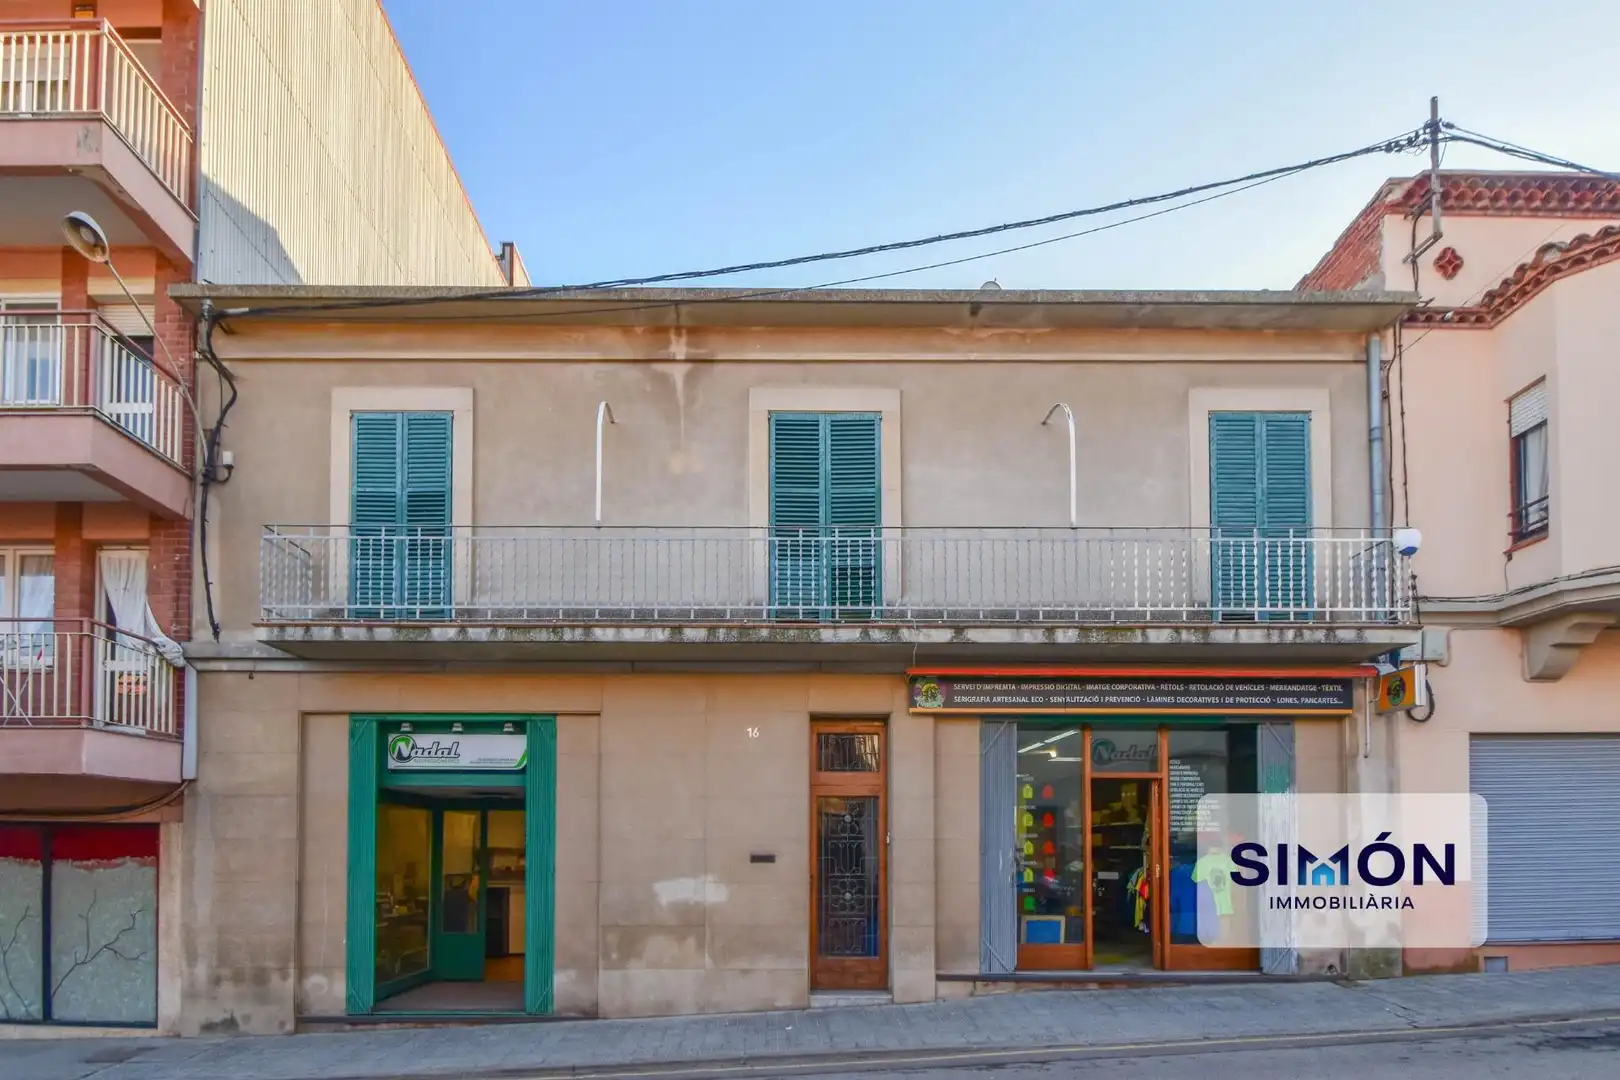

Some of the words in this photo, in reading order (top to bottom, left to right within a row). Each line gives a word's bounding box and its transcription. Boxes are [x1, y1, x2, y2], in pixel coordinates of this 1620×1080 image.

[1086, 683, 1110, 691] IMATGE
[1111, 683, 1156, 691] CORPORATIVA
[1269, 684, 1317, 692] MERXANDATGE
[1049, 695, 1099, 703] SENYALITZACIÓ
[1104, 695, 1140, 703] PREVENCIÓ
[1176, 696, 1219, 704] DECORATIVES
[1225, 696, 1234, 704] DE
[1235, 695, 1271, 704] PROTECCIÓ
[746, 727, 760, 739] 16
[390, 737, 461, 761] Nadal
